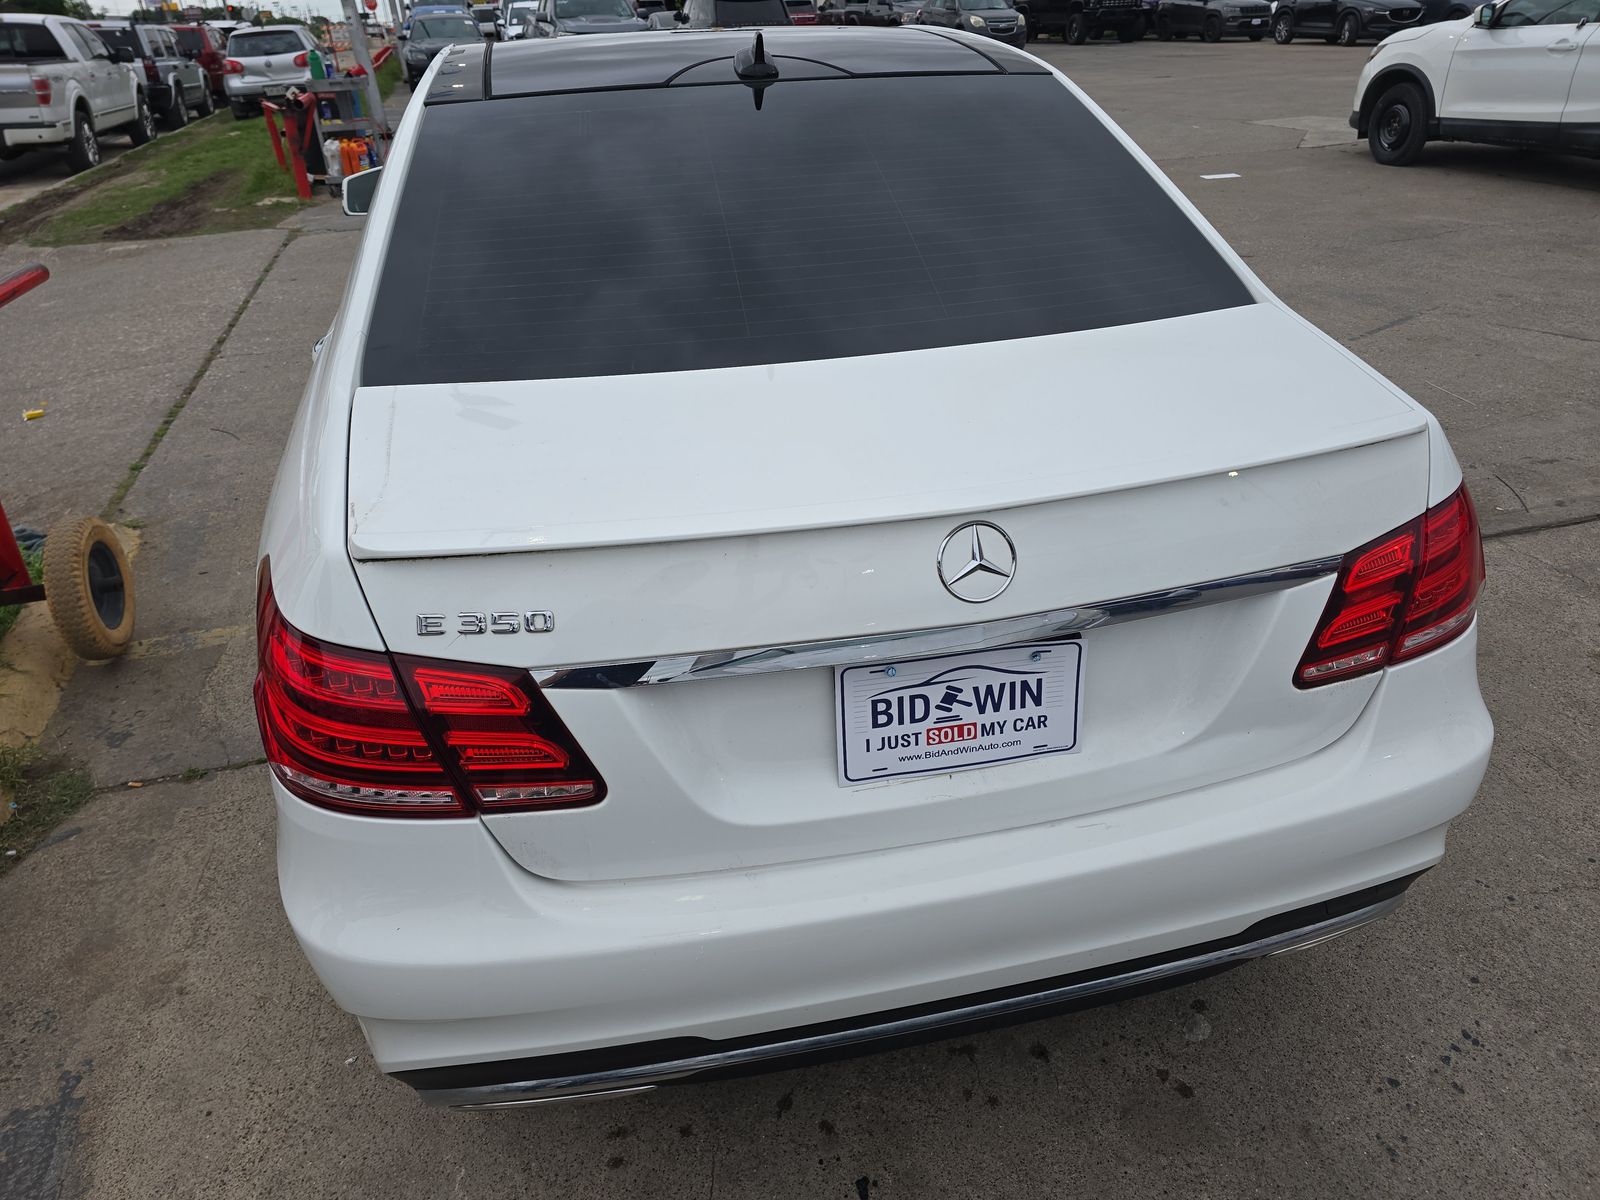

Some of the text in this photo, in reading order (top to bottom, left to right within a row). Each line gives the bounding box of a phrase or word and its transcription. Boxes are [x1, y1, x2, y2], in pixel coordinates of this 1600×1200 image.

[416, 610, 555, 636] E 350
[870, 678, 1043, 729] BID WIN
[865, 714, 1048, 753] I JUST SOLD MY CAR
[898, 738, 1022, 762] www.BidAndWinAuto.com
